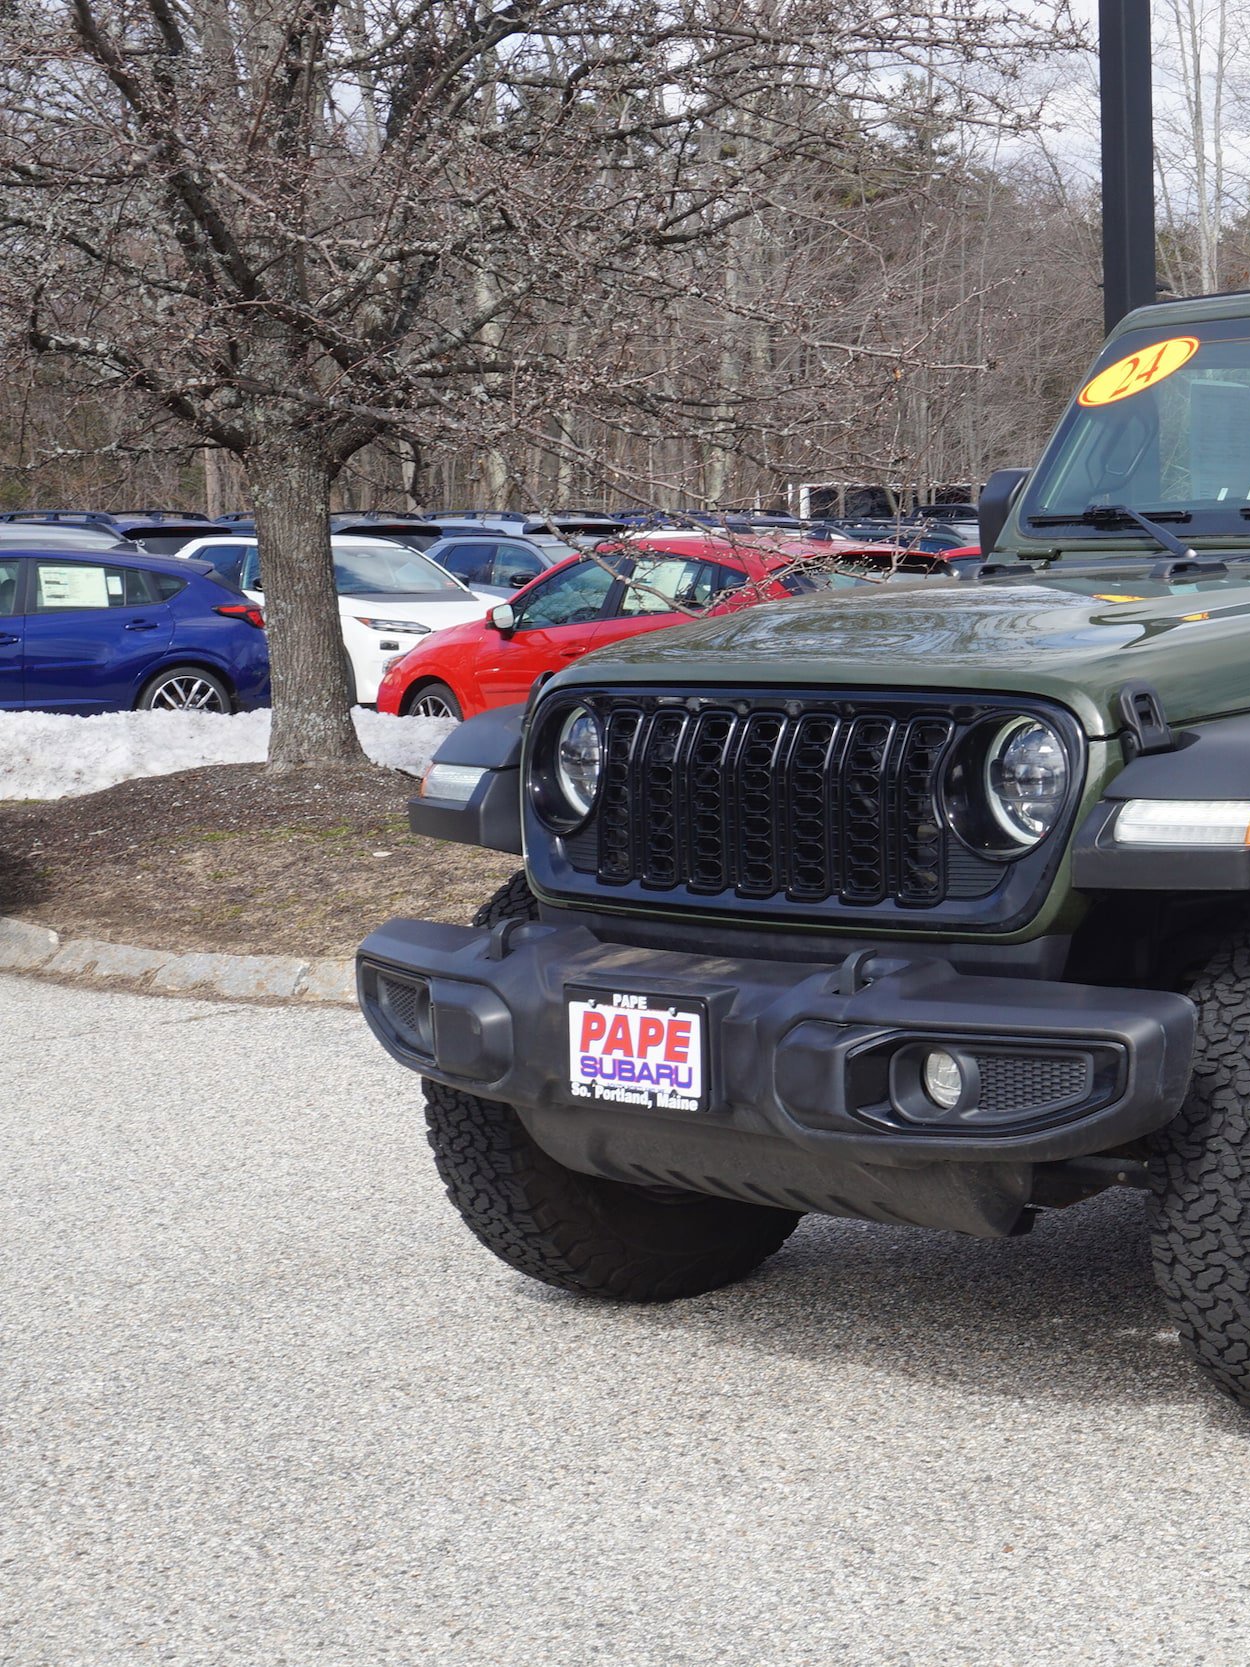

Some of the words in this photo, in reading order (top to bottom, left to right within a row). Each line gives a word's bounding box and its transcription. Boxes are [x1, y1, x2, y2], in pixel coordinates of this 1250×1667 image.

[1109, 343, 1168, 399] 24
[613, 994, 647, 1009] PAPE
[580, 1011, 691, 1063] PAPE
[580, 1055, 693, 1089] SUBARU
[571, 1082, 591, 1098] So.
[595, 1085, 653, 1109] Portland,
[656, 1092, 699, 1111] Maine
